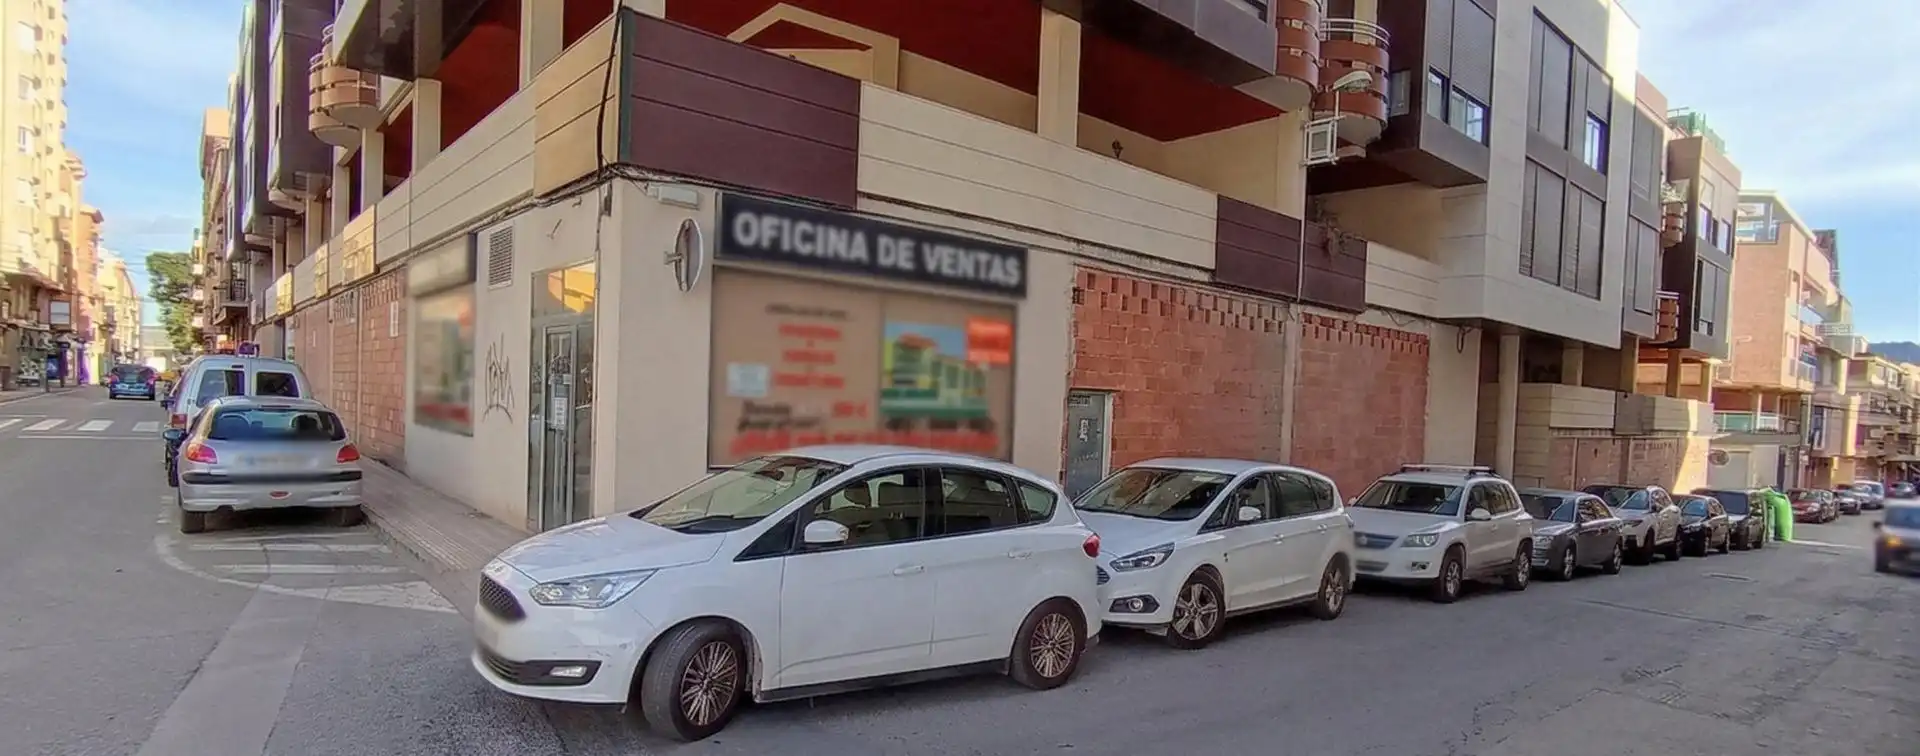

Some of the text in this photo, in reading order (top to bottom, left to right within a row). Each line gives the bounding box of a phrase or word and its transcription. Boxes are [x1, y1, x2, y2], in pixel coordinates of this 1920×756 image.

[733, 212, 1020, 285] OFICINA DE VENTAS
